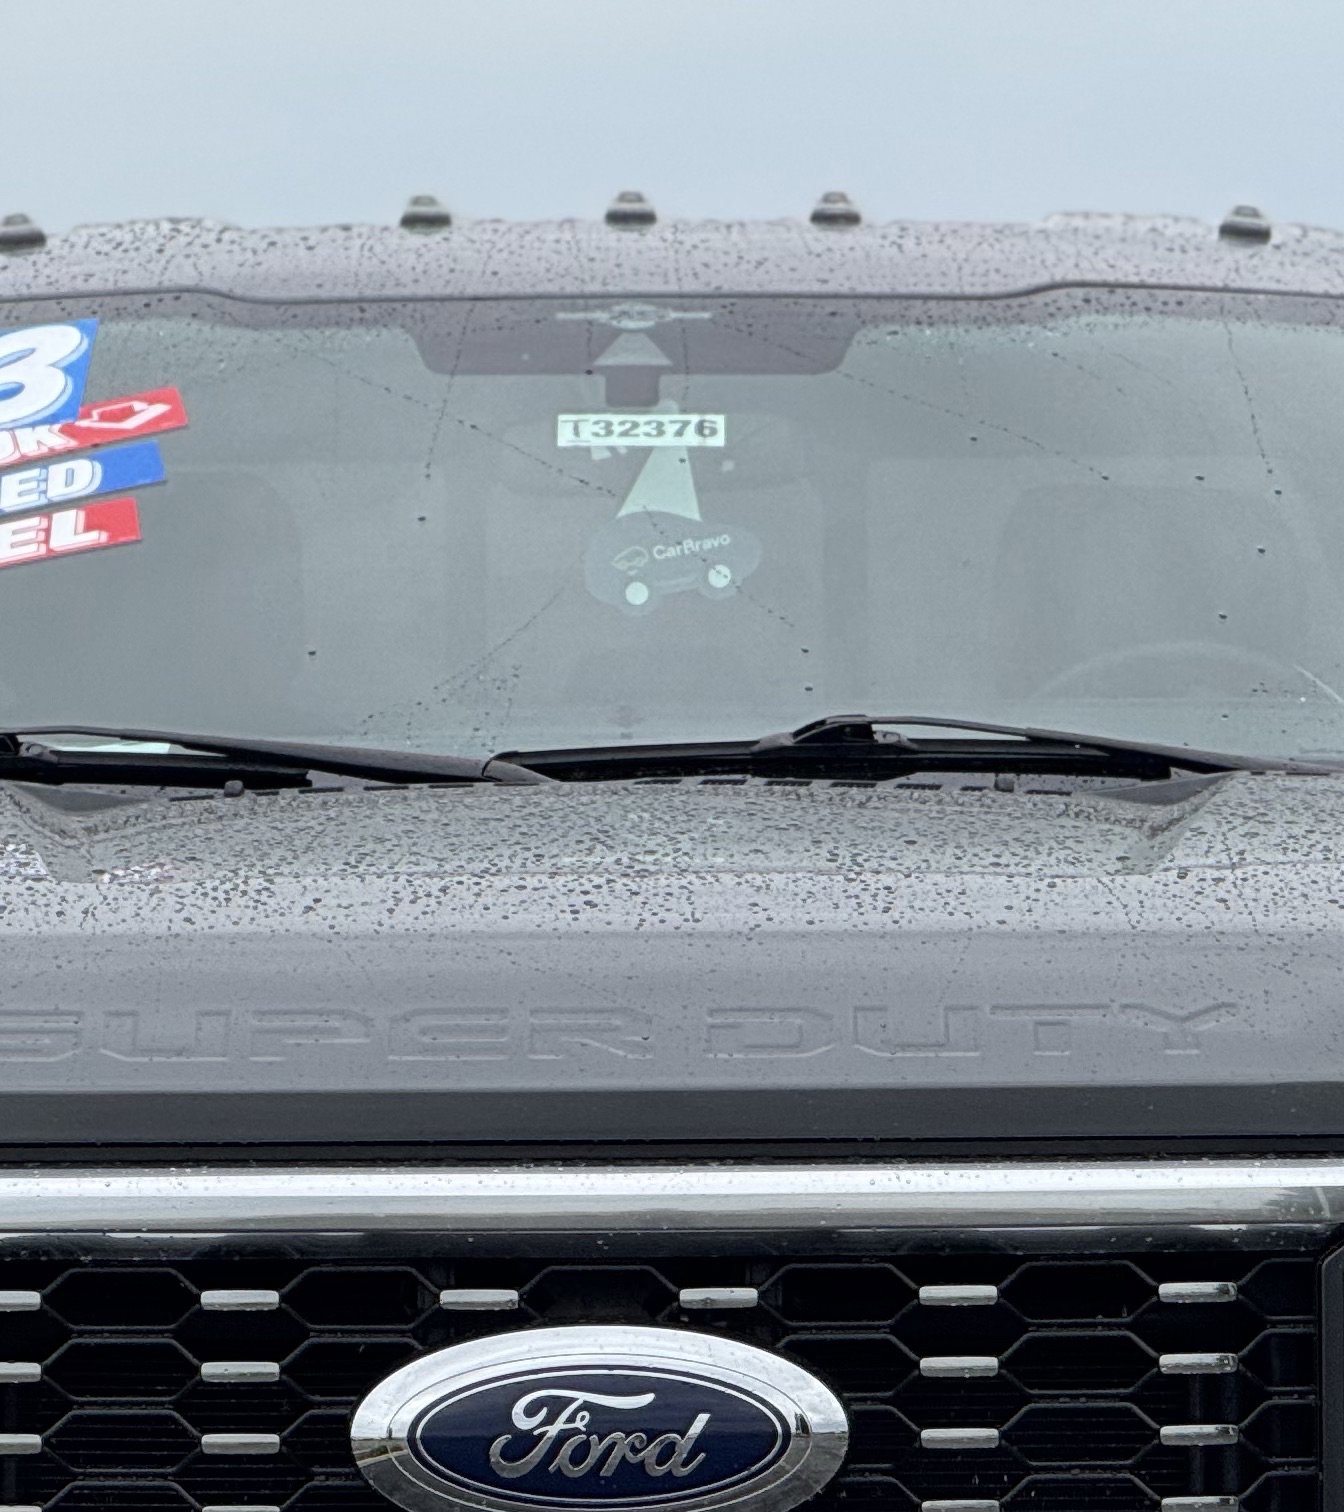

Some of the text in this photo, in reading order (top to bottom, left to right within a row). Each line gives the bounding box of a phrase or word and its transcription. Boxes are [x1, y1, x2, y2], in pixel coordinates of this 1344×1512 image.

[562, 418, 719, 439] T32376
[653, 533, 731, 560] CarBravo
[706, 1002, 1237, 1058] DUTY
[488, 1388, 711, 1479] Ford
